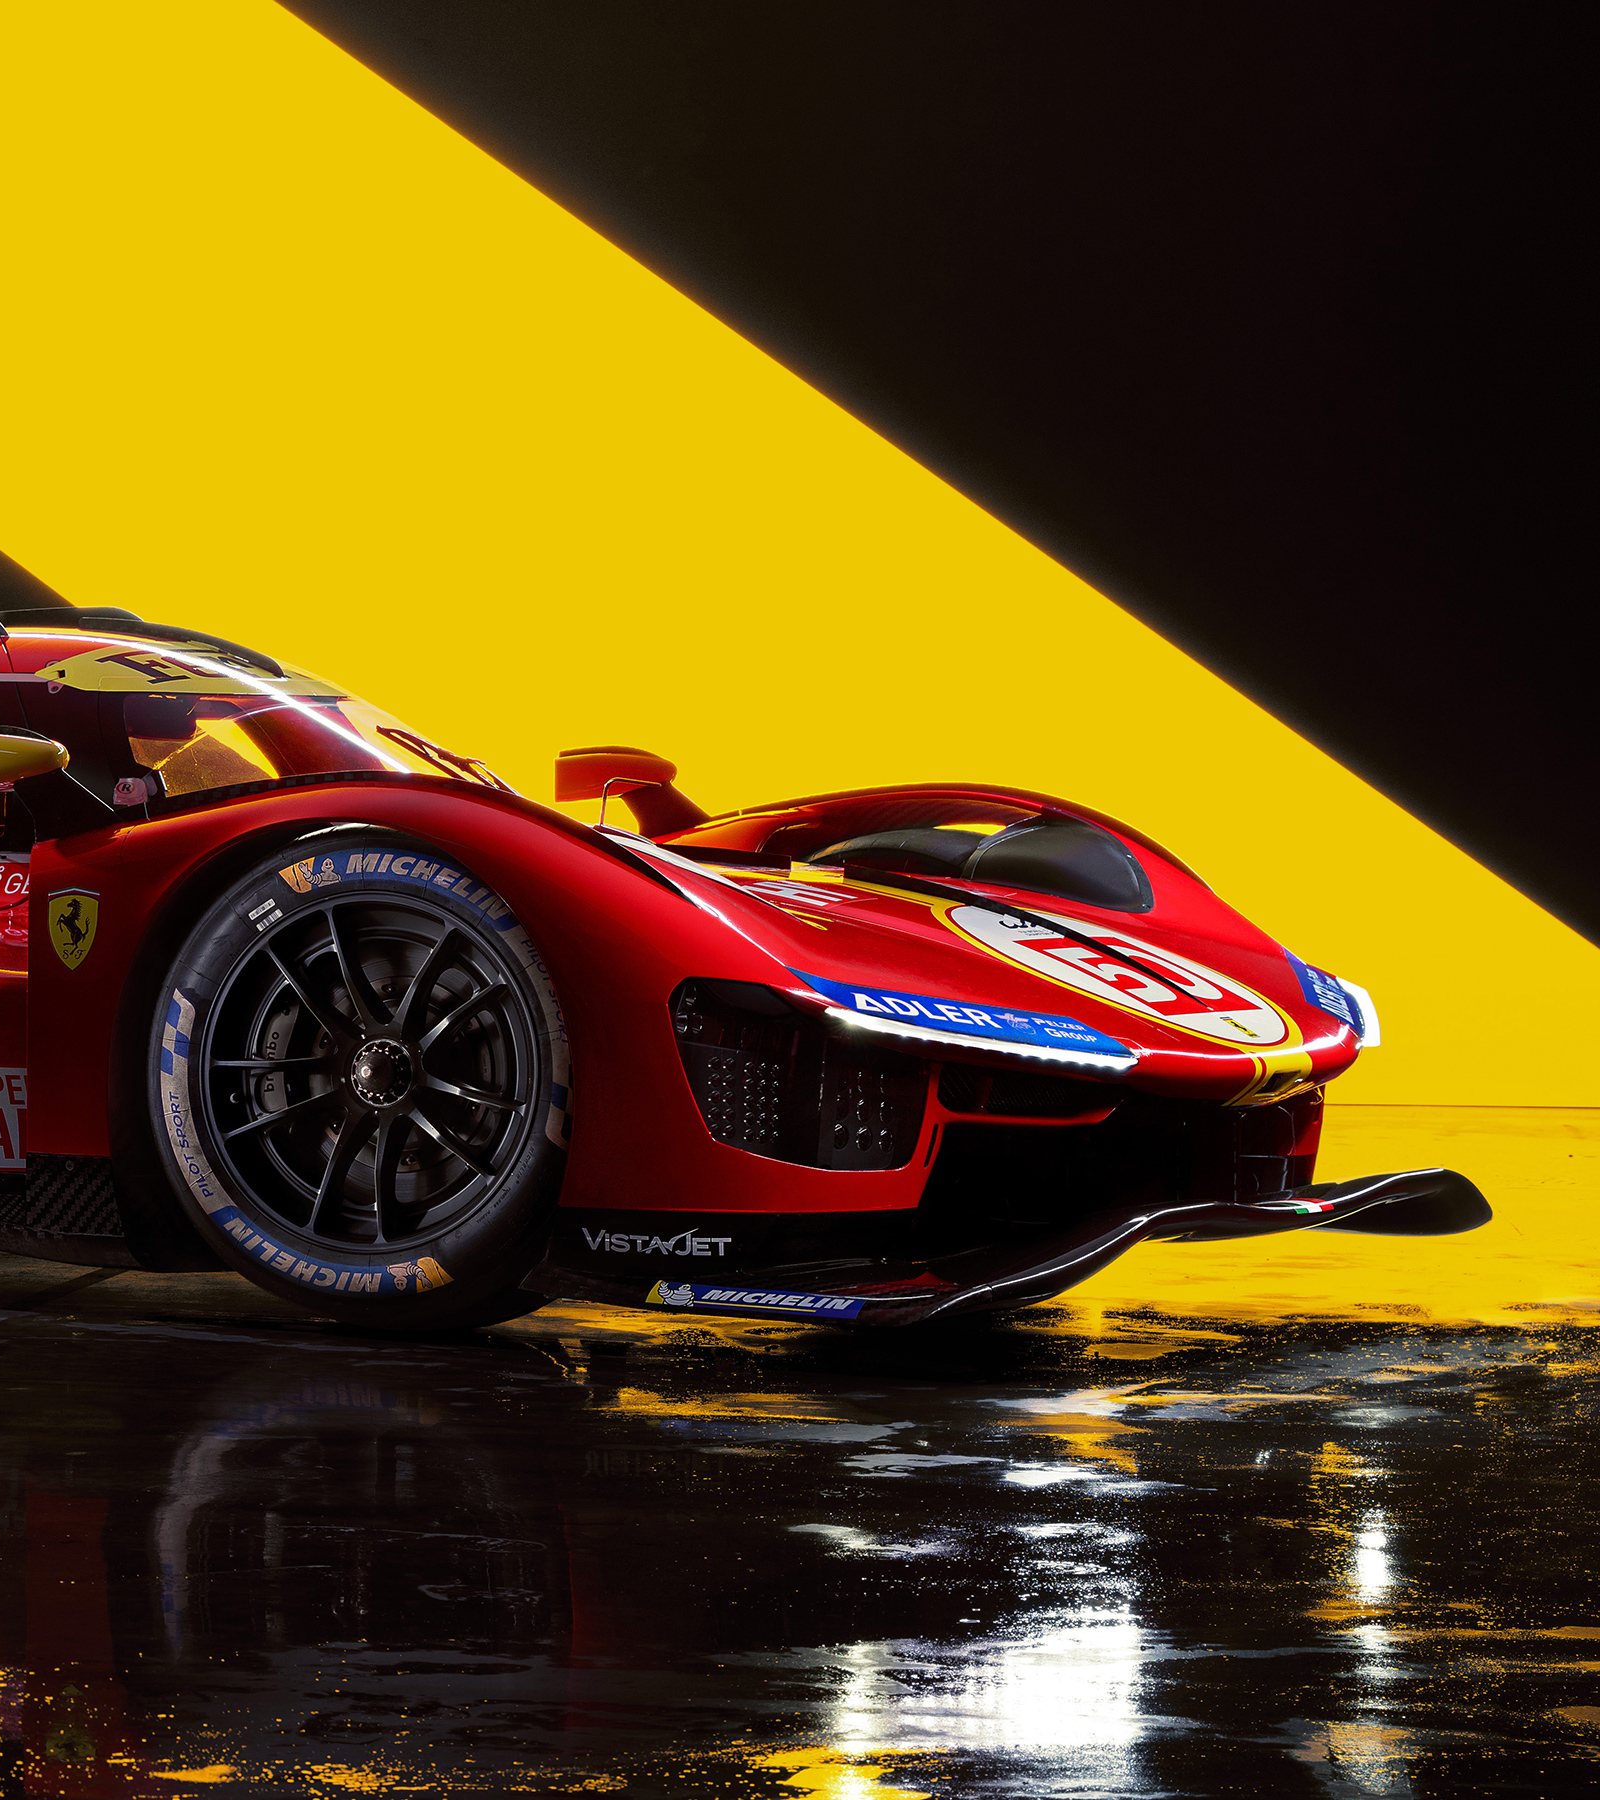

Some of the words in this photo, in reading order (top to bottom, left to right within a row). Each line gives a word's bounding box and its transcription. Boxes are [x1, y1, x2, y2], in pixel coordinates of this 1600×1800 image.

[345, 853, 510, 921] MICHELIN
[852, 992, 1002, 1029] ADLER
[1033, 1017, 1088, 1032] PELZER
[1046, 1027, 1098, 1043] GROUP
[264, 1032, 280, 1092] brmbo
[168, 1091, 190, 1149] SPORT
[184, 1153, 214, 1198] PILOT
[223, 1217, 382, 1293] MICHELIN
[701, 1289, 854, 1311] MICHELIN
